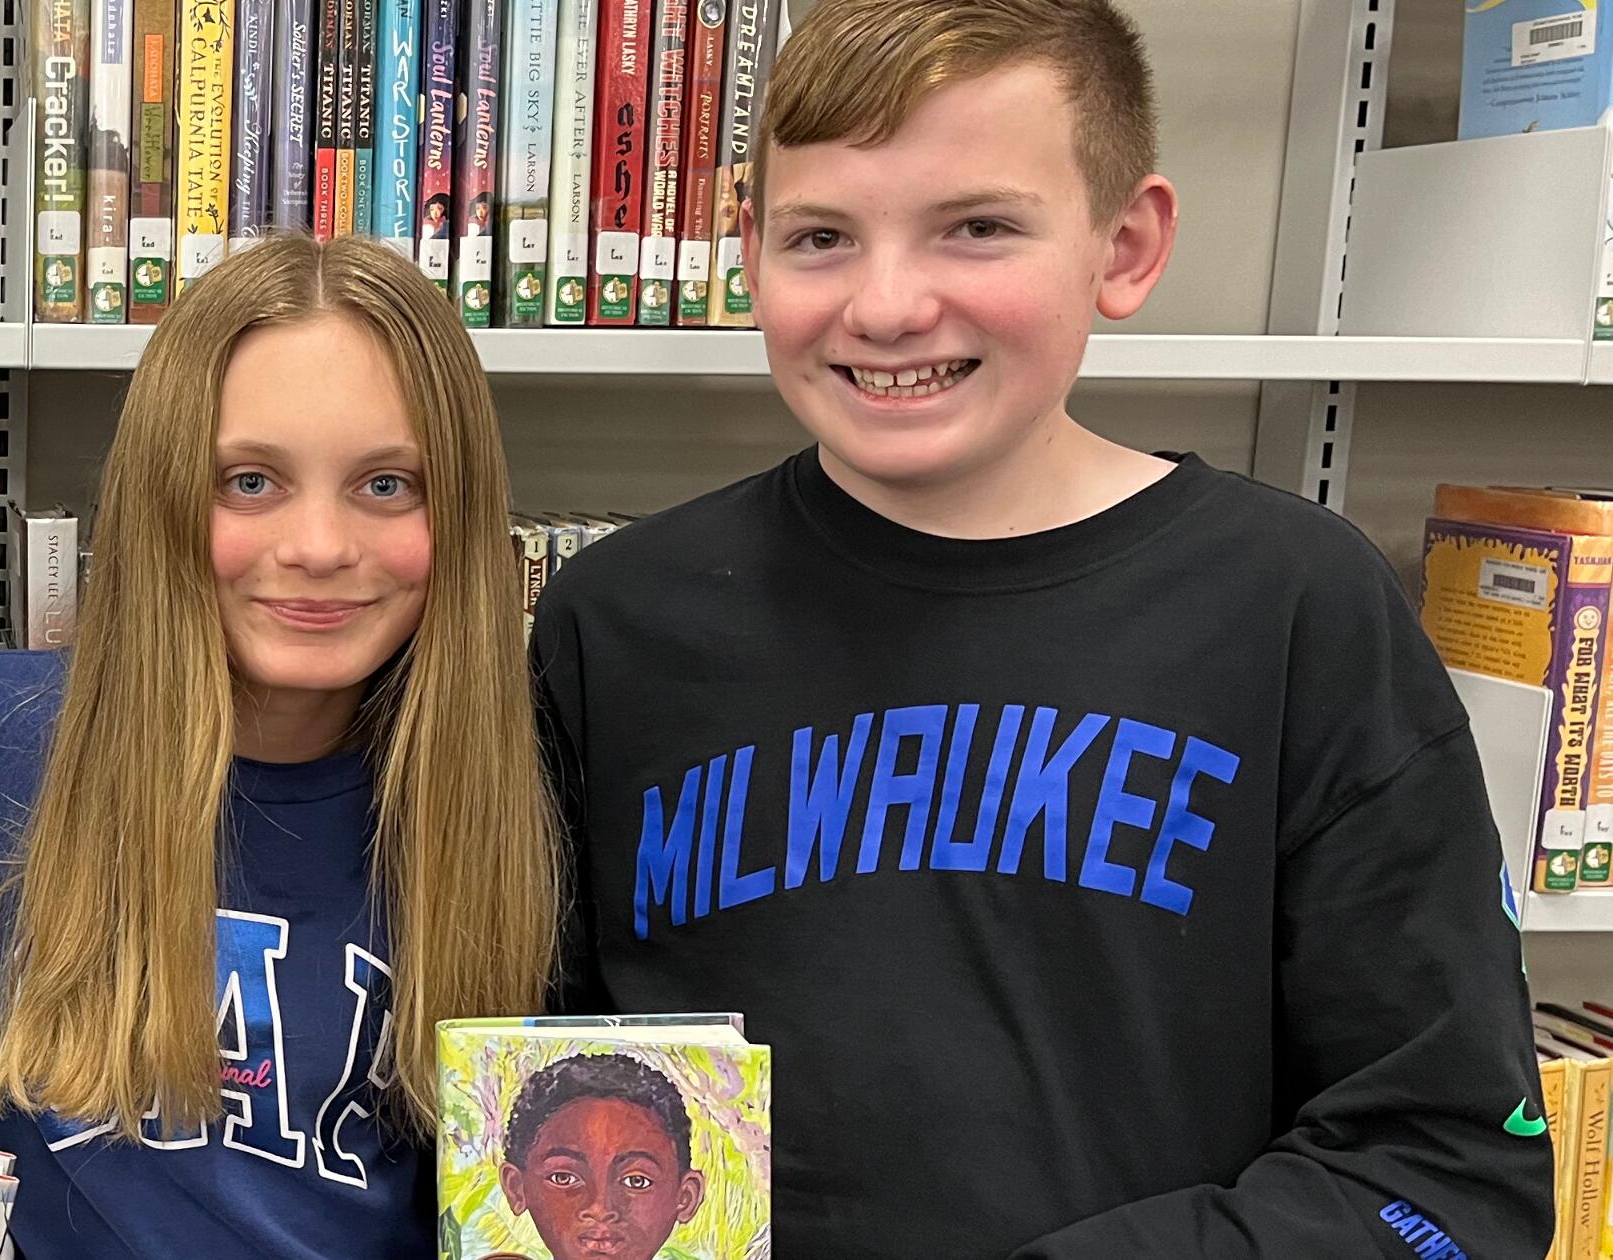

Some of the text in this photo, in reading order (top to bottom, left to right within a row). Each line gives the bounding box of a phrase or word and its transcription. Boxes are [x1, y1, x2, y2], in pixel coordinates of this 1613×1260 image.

[289, 20, 307, 148] Soldier's SECRET
[392, 26, 413, 107] WAR
[621, 42, 636, 76] LASKY
[705, 36, 715, 67] LASKY
[731, 4, 758, 154] DREAMLAND
[44, 56, 76, 200] Cracker!
[187, 37, 208, 218] CALPURNIA TATE
[210, 83, 225, 182] EVOLUTION
[321, 63, 334, 139] TITANIC
[340, 64, 352, 139] TITANIC
[359, 64, 372, 139] TITANIC
[427, 41, 454, 170] Soul Lanterns
[474, 39, 498, 169] Soul Lanterns
[525, 52, 541, 192] BIG SKY LARSON
[572, 38, 589, 223] EVER AFTER LARSON
[654, 49, 685, 168] WITCHES
[698, 92, 713, 160] PORTRAITS
[236, 120, 263, 196] Keeping
[321, 167, 329, 196] BOOK
[341, 152, 349, 179] BOOK
[358, 160, 367, 186] BOOK
[652, 170, 667, 210] WORLD
[665, 170, 677, 233] A NOVEL OF
[47, 535, 59, 600] STACEY LEE
[533, 540, 539, 553] 1
[564, 538, 573, 551] 2
[1558, 637, 1595, 808] FOR WHAT WORTH
[633, 704, 1241, 942] MILWAUKEE
[1580, 1110, 1604, 1229] Wolf Hollow
